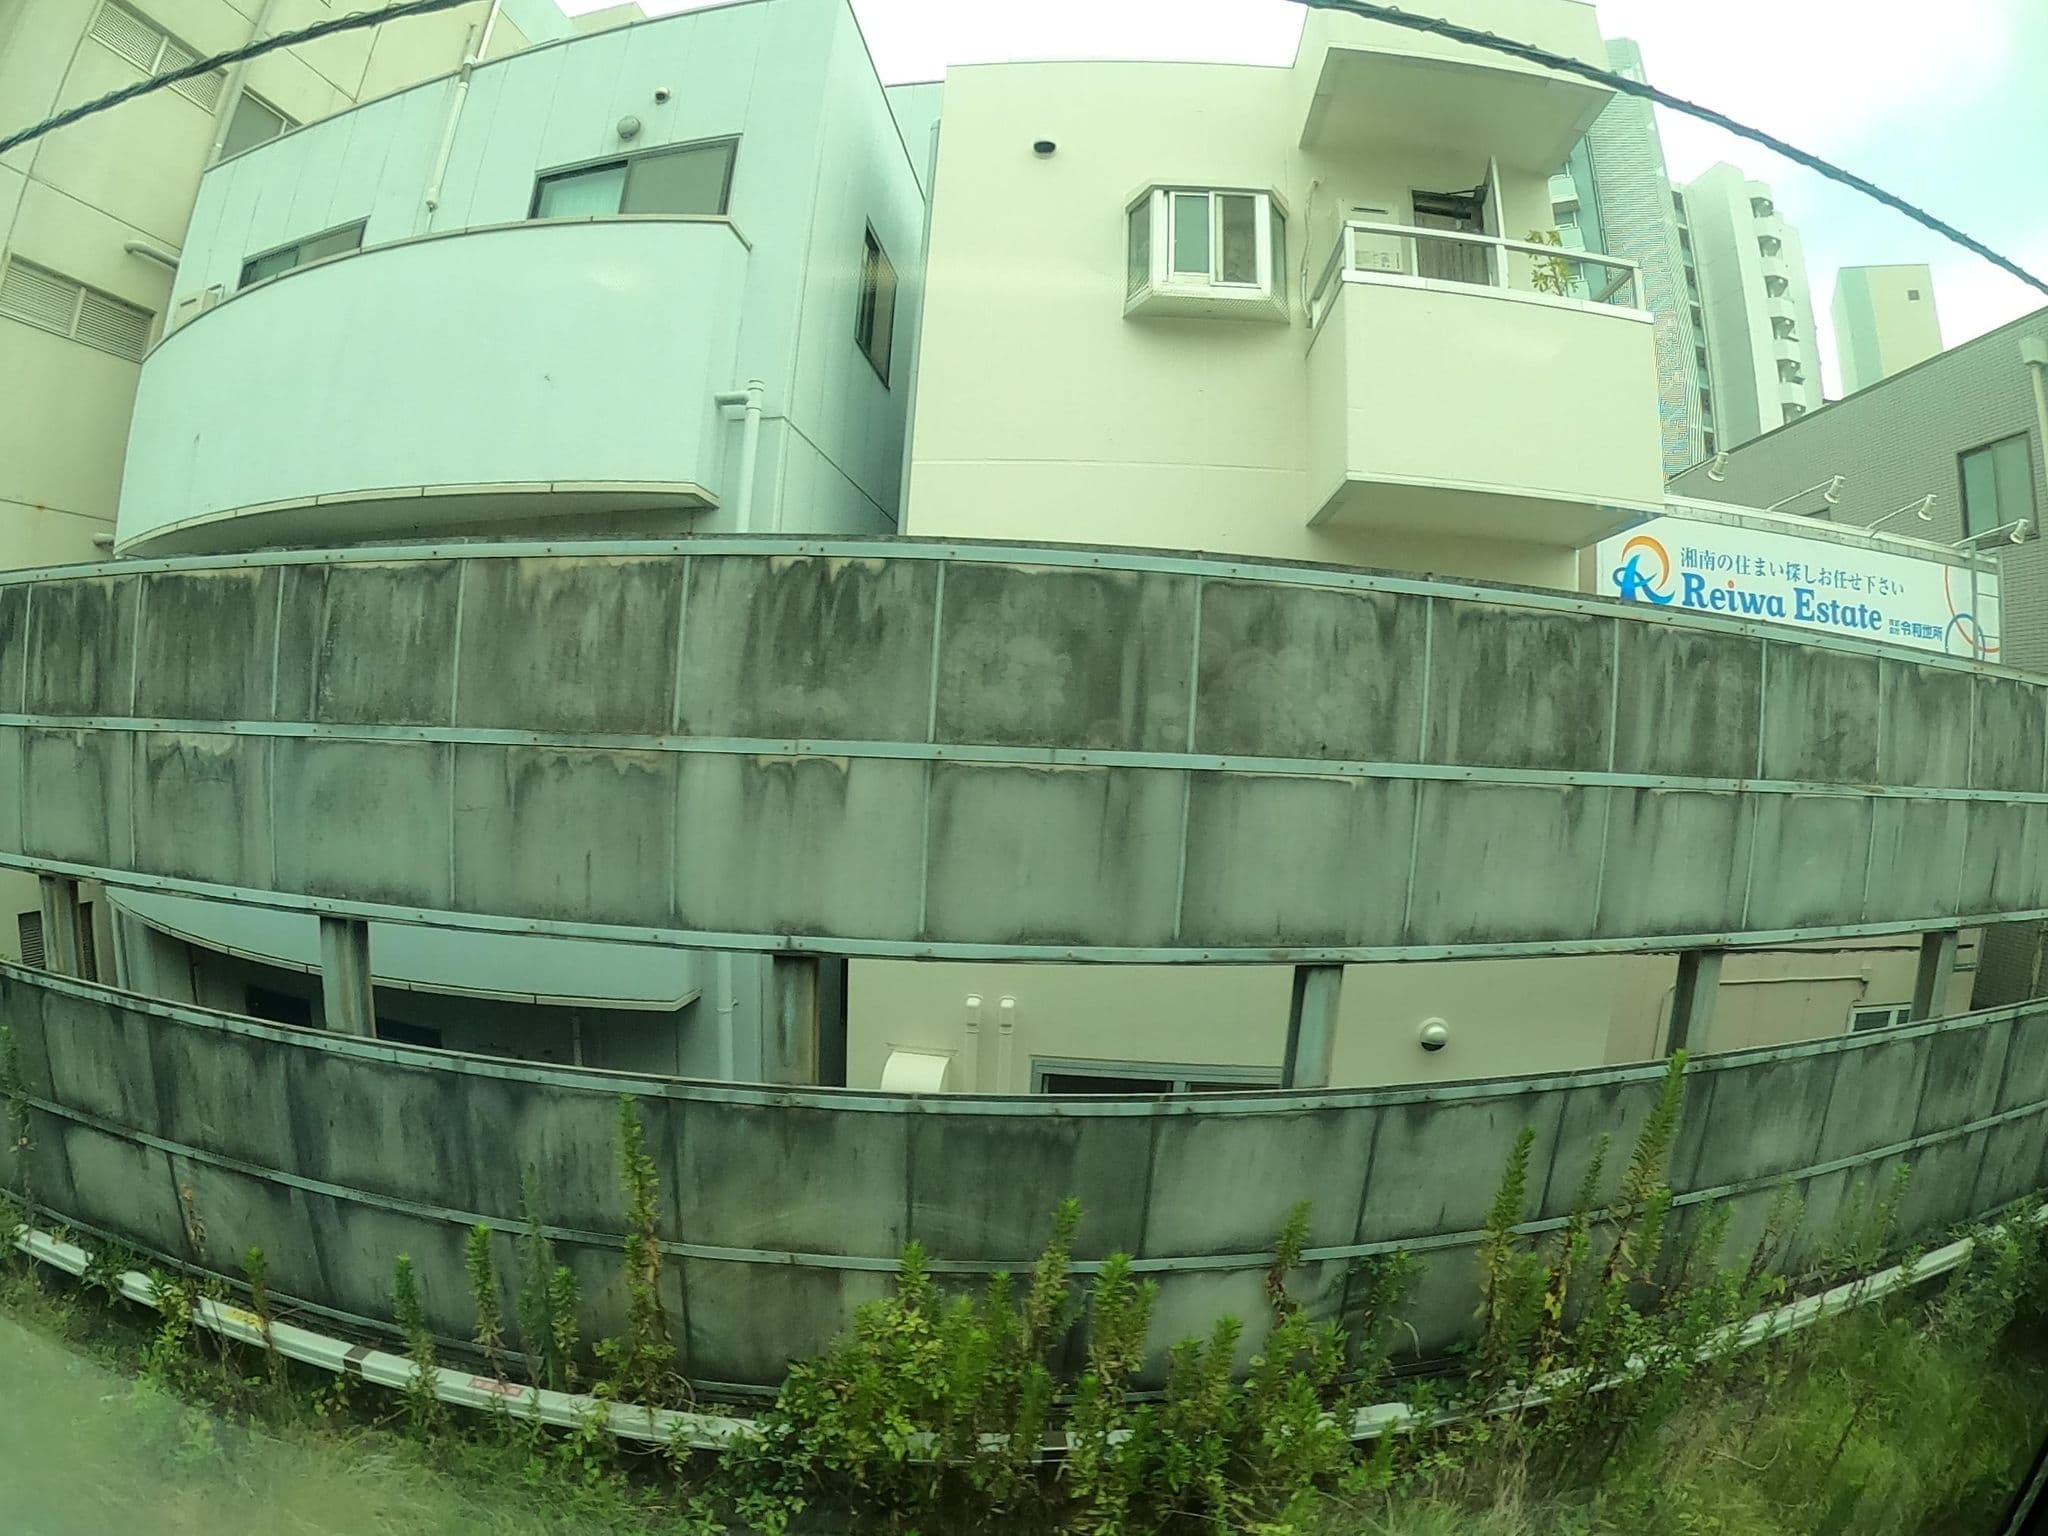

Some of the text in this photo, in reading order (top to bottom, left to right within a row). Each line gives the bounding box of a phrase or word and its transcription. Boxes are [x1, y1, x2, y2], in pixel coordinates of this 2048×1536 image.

[1681, 547, 1904, 596] 湘南の住まい探しお任せ下さい
[1682, 572, 1882, 631] Reiwa Estate
